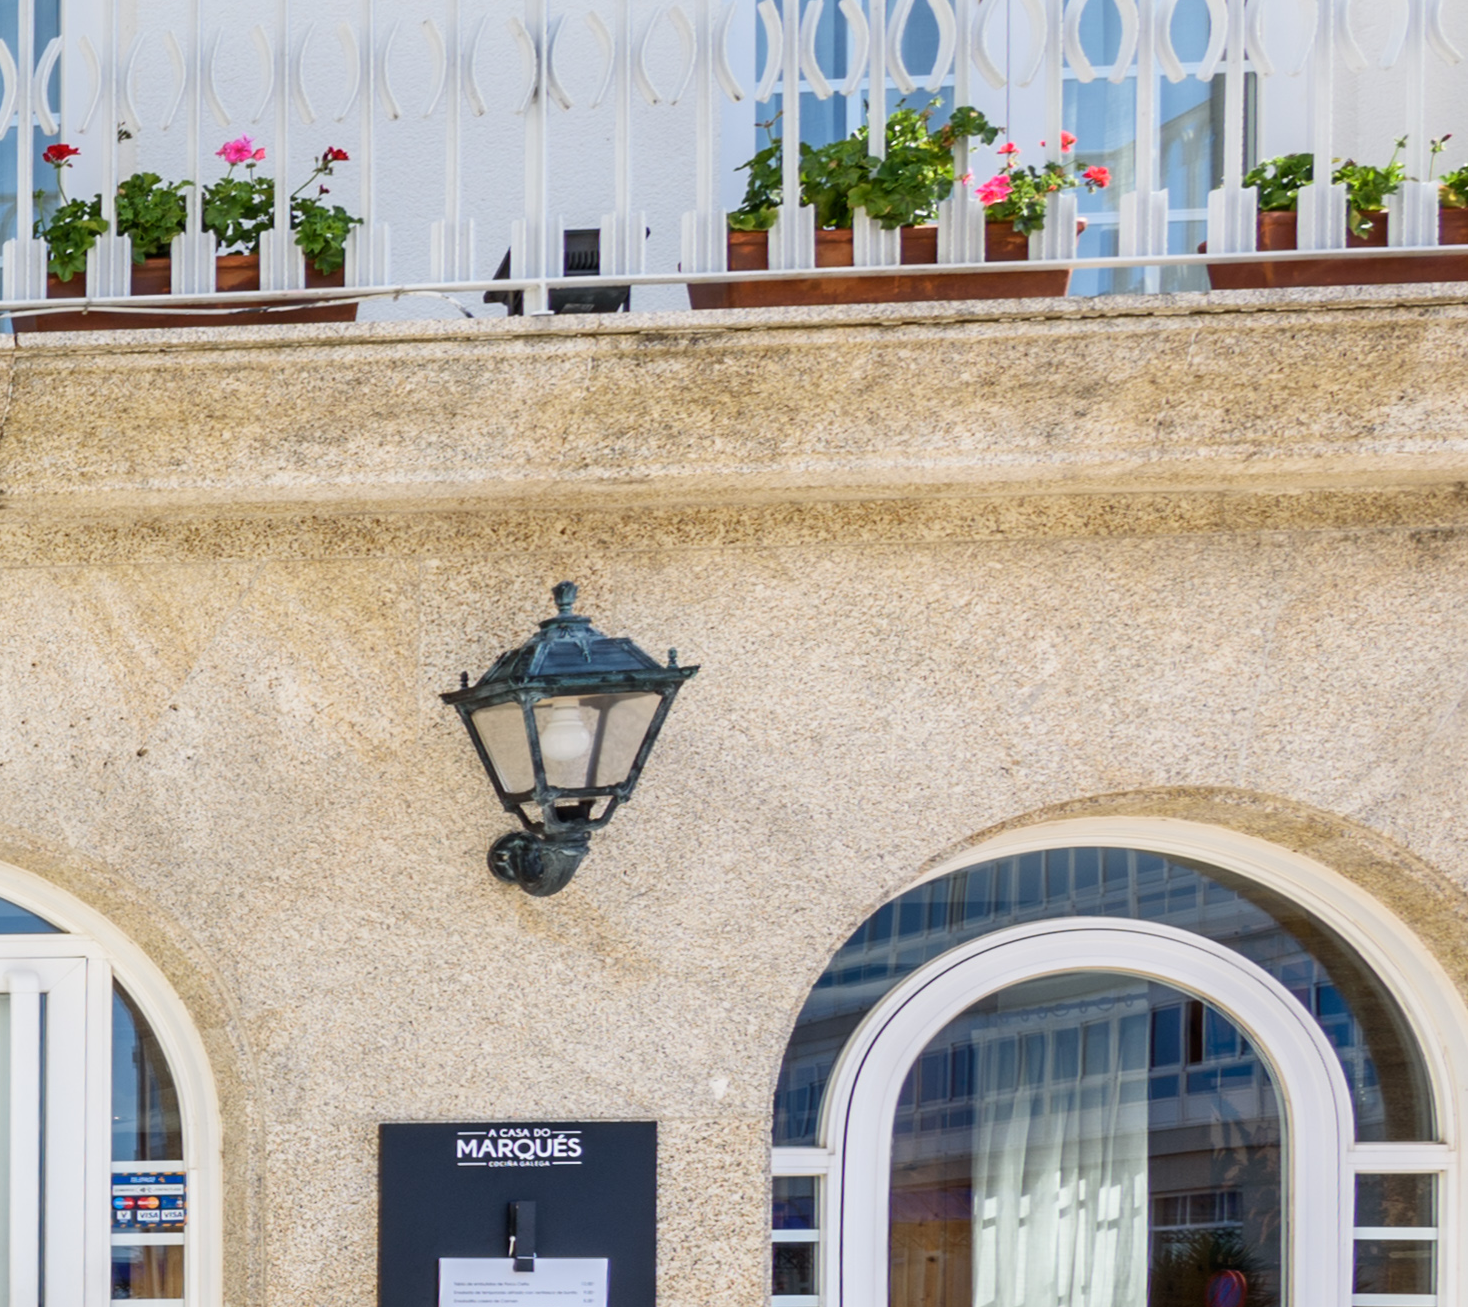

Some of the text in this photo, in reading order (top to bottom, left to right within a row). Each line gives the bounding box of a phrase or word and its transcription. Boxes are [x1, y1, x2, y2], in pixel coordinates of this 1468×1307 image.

[488, 1127, 551, 1137] A CASA DO
[456, 1134, 582, 1160] MARQUÉS
